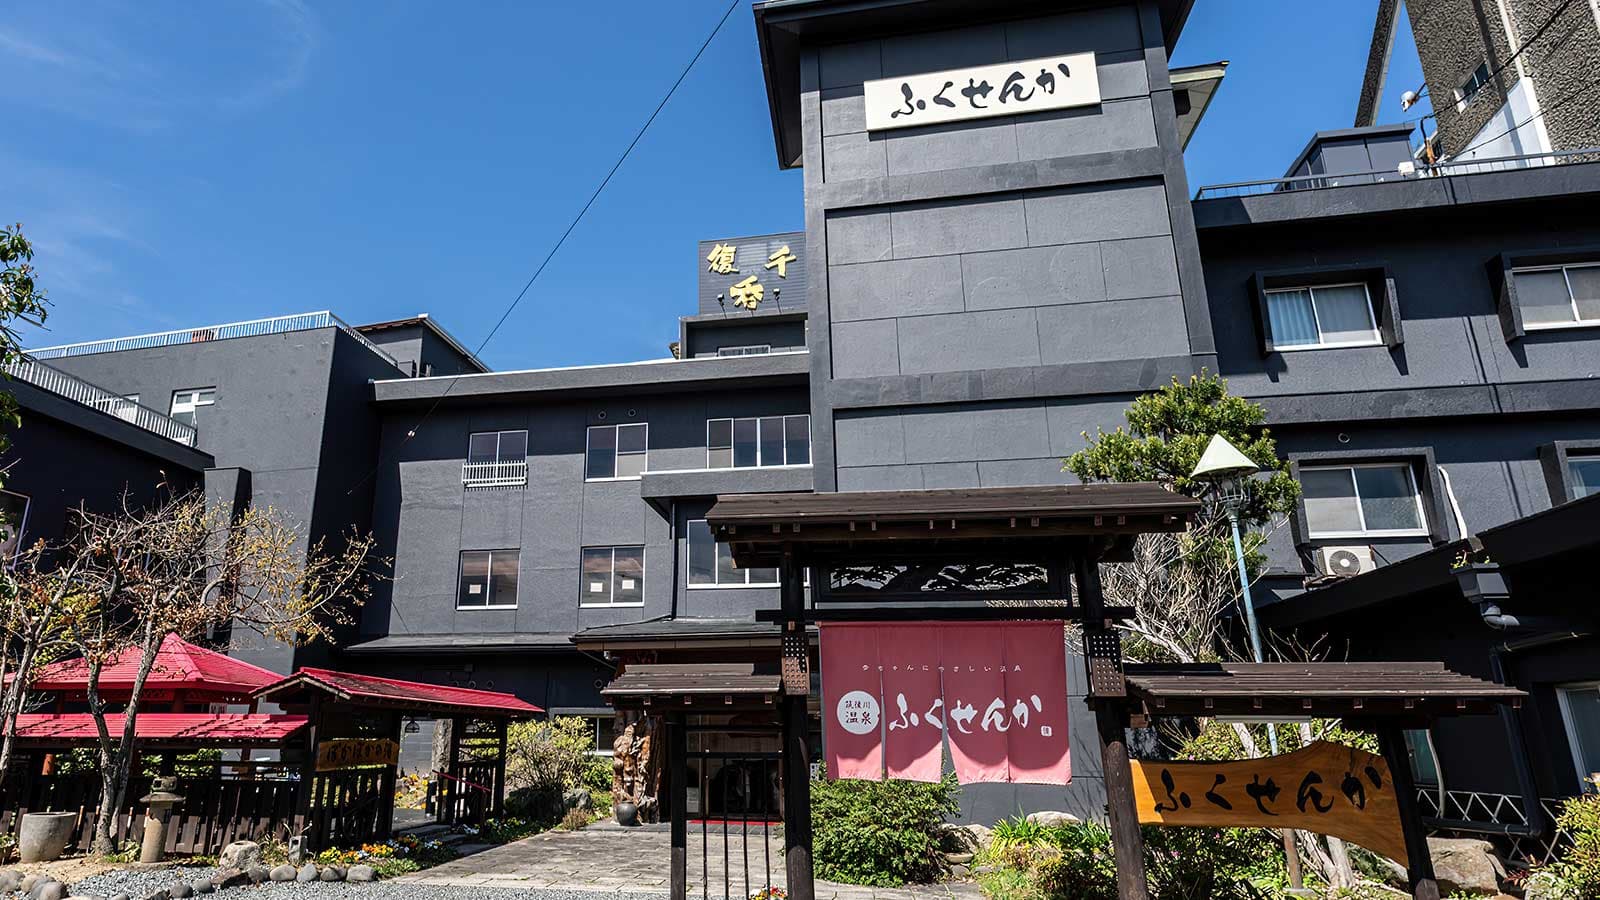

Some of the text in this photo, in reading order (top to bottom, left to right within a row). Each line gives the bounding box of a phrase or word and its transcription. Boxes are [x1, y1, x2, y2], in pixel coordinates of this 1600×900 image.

[891, 63, 1070, 119] ふくせんか
[845, 711, 872, 725] 温泉
[889, 693, 1042, 734] ふくせんか
[1154, 766, 1382, 816] ふくせんか
